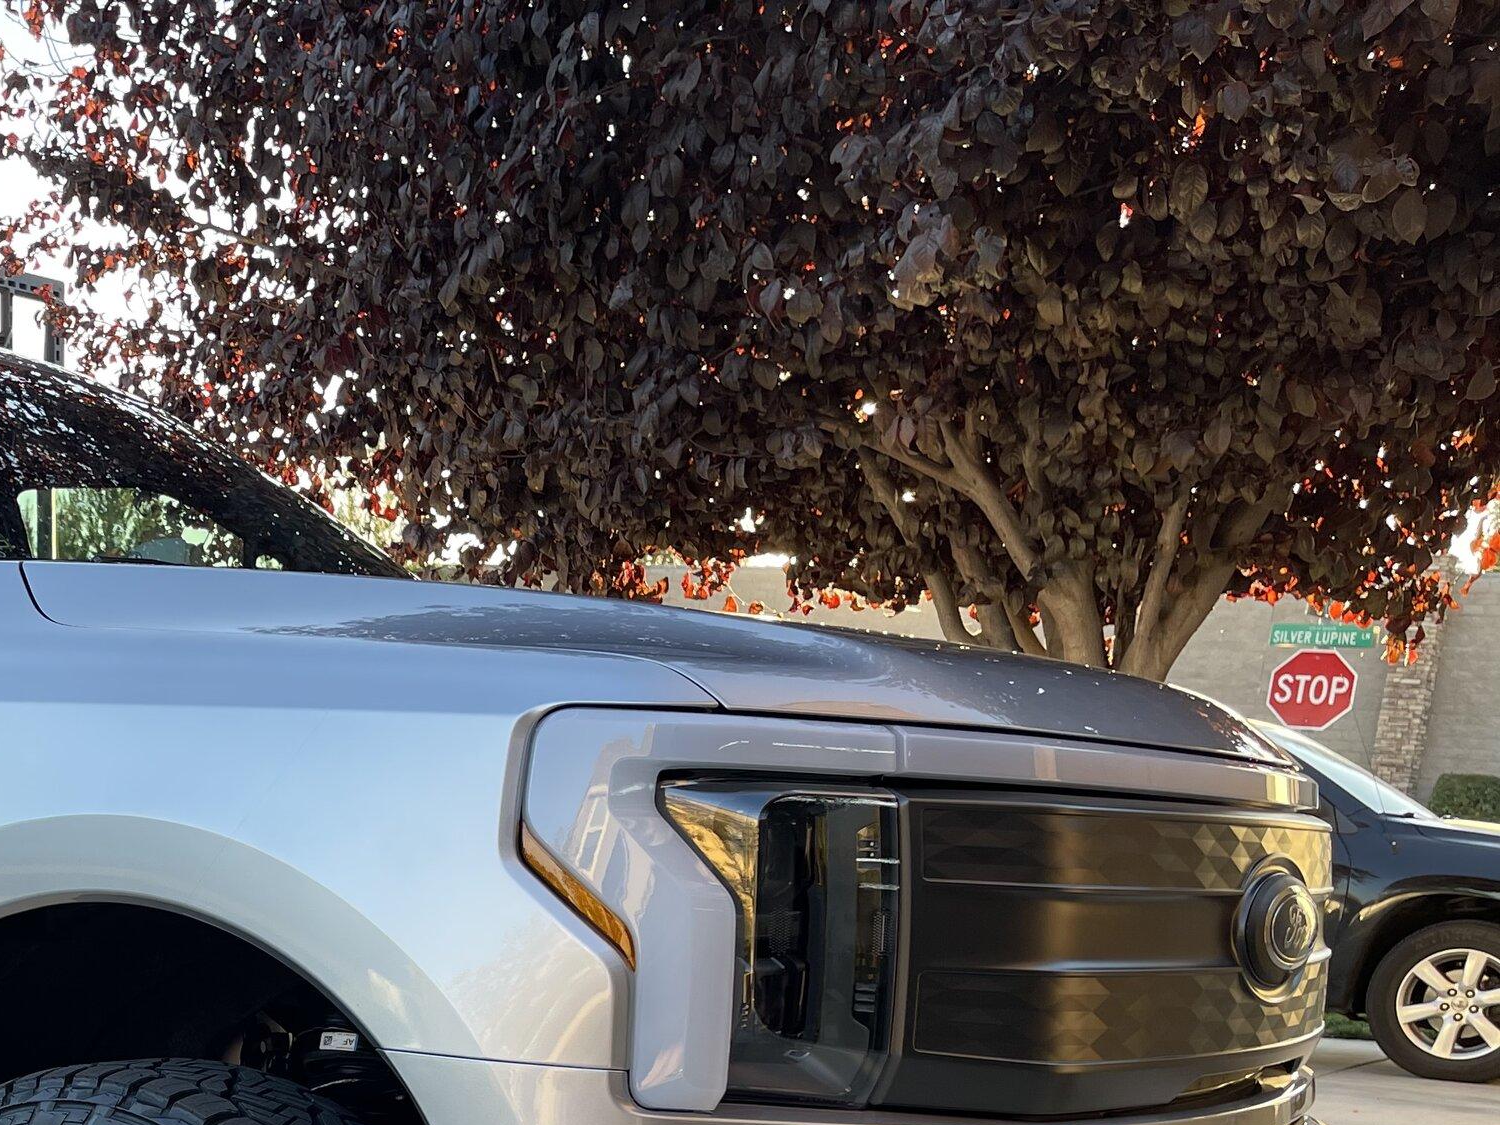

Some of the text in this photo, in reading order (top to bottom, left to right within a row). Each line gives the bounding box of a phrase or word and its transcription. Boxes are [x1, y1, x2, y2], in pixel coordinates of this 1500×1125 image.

[1273, 630, 1371, 646] SILVER LUPINE LN
[1274, 673, 1350, 706] STOP
